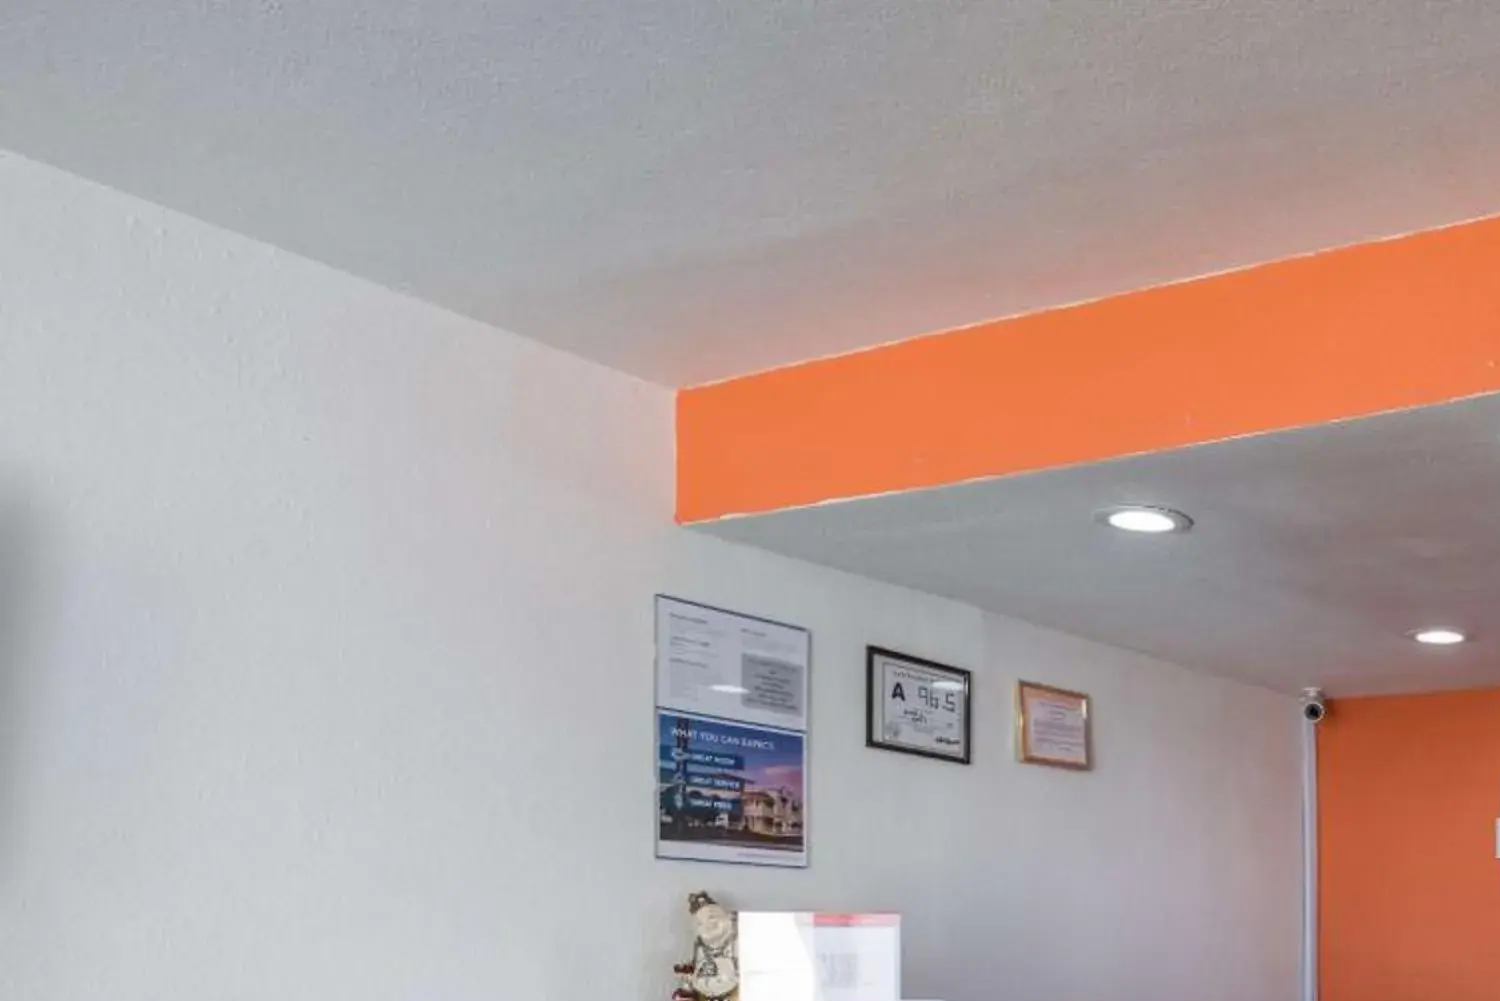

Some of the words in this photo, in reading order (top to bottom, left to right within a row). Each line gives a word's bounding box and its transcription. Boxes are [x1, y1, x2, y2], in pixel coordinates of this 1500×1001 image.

[891, 681, 906, 702] A
[700, 731, 719, 743] YOU
[721, 734, 740, 746] CAN
